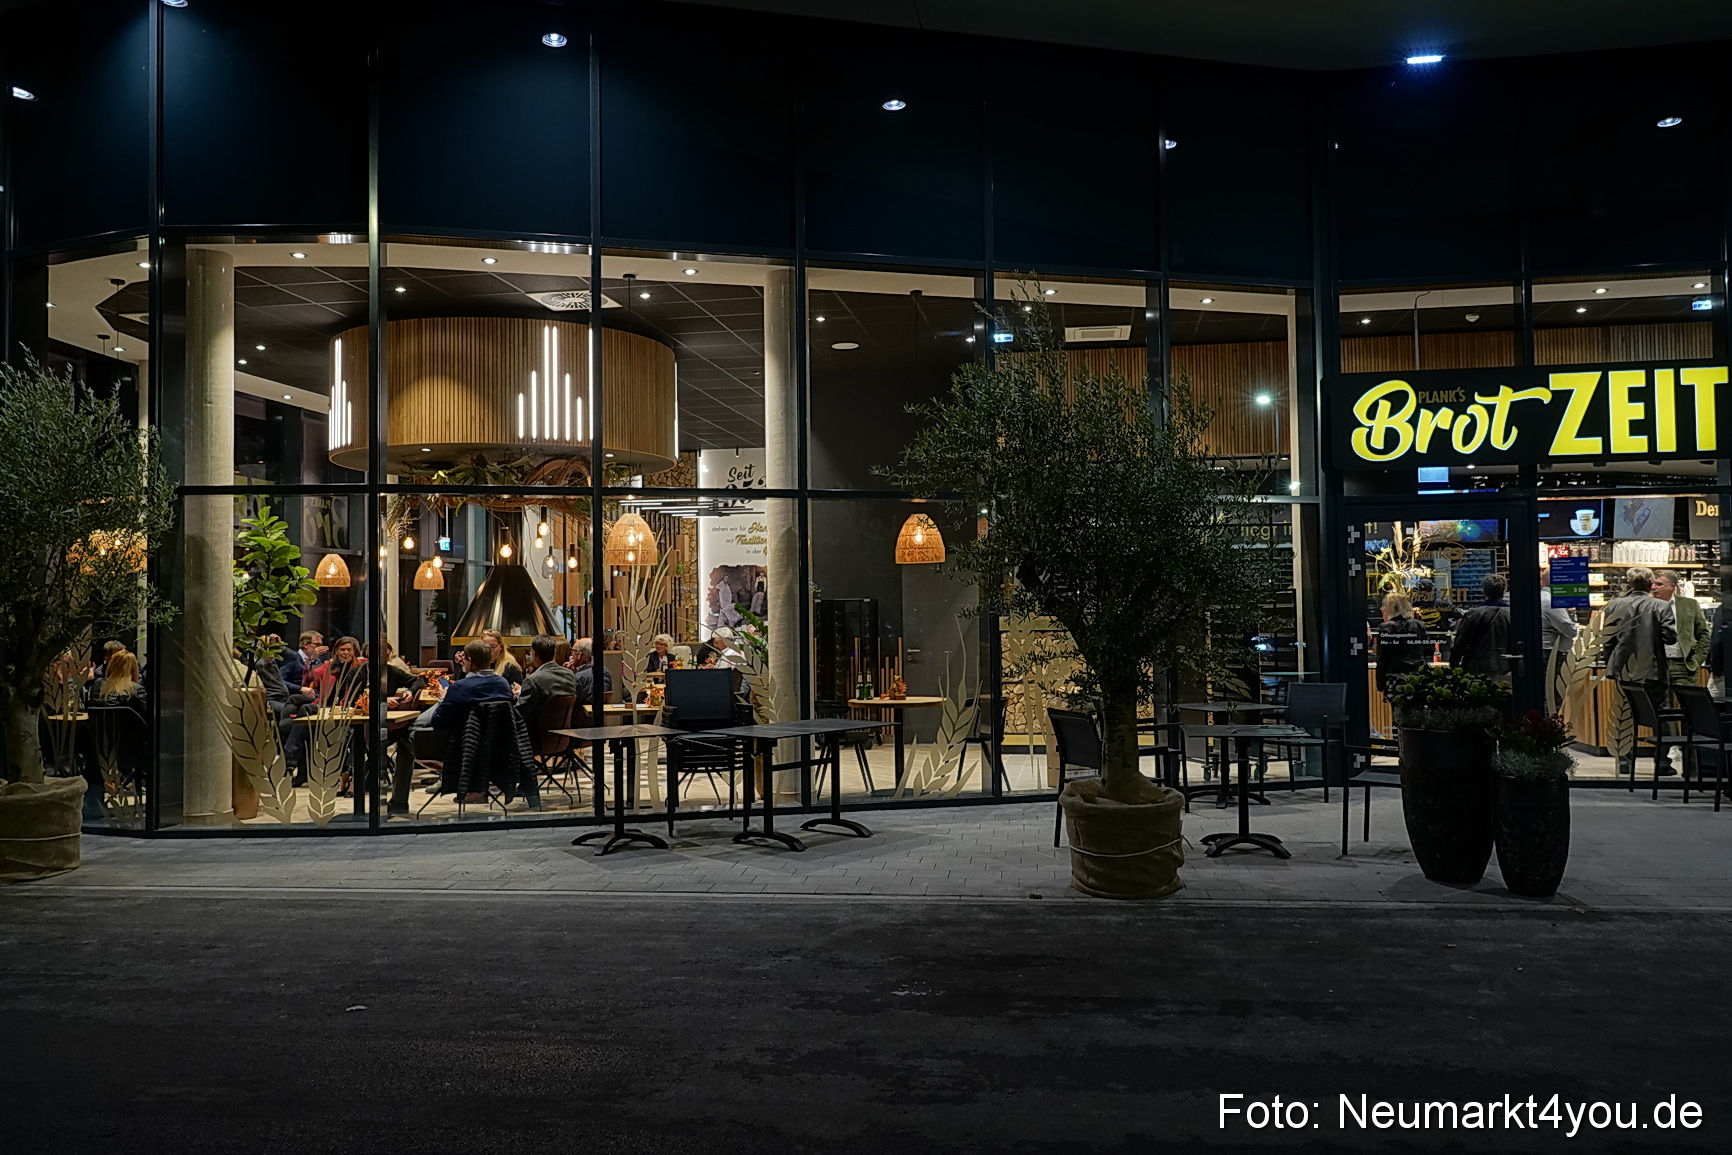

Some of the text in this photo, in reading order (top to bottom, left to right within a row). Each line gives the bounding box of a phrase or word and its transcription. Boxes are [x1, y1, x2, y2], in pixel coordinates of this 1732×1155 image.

[1418, 387, 1466, 404] PLANK'S
[1351, 366, 1729, 462] Brot ZEIT
[727, 463, 756, 483] Seit
